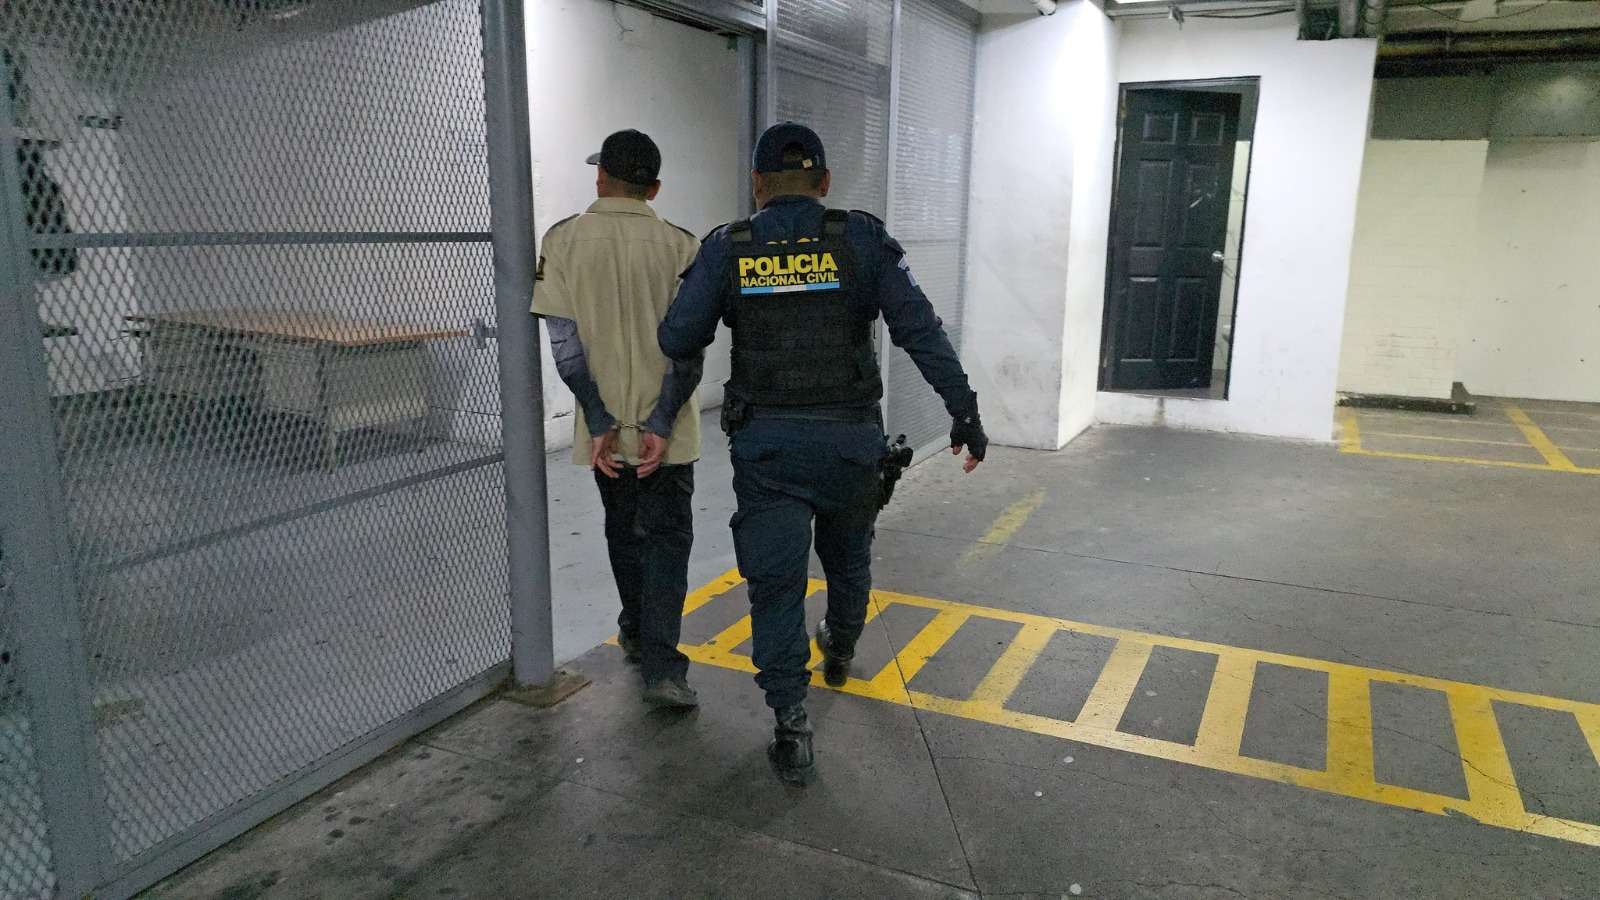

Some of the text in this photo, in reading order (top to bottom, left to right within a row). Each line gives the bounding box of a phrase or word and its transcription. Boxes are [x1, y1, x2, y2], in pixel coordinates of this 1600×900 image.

[738, 252, 838, 277] POLICIA
[740, 271, 840, 288] NACIONAL CIVIL
